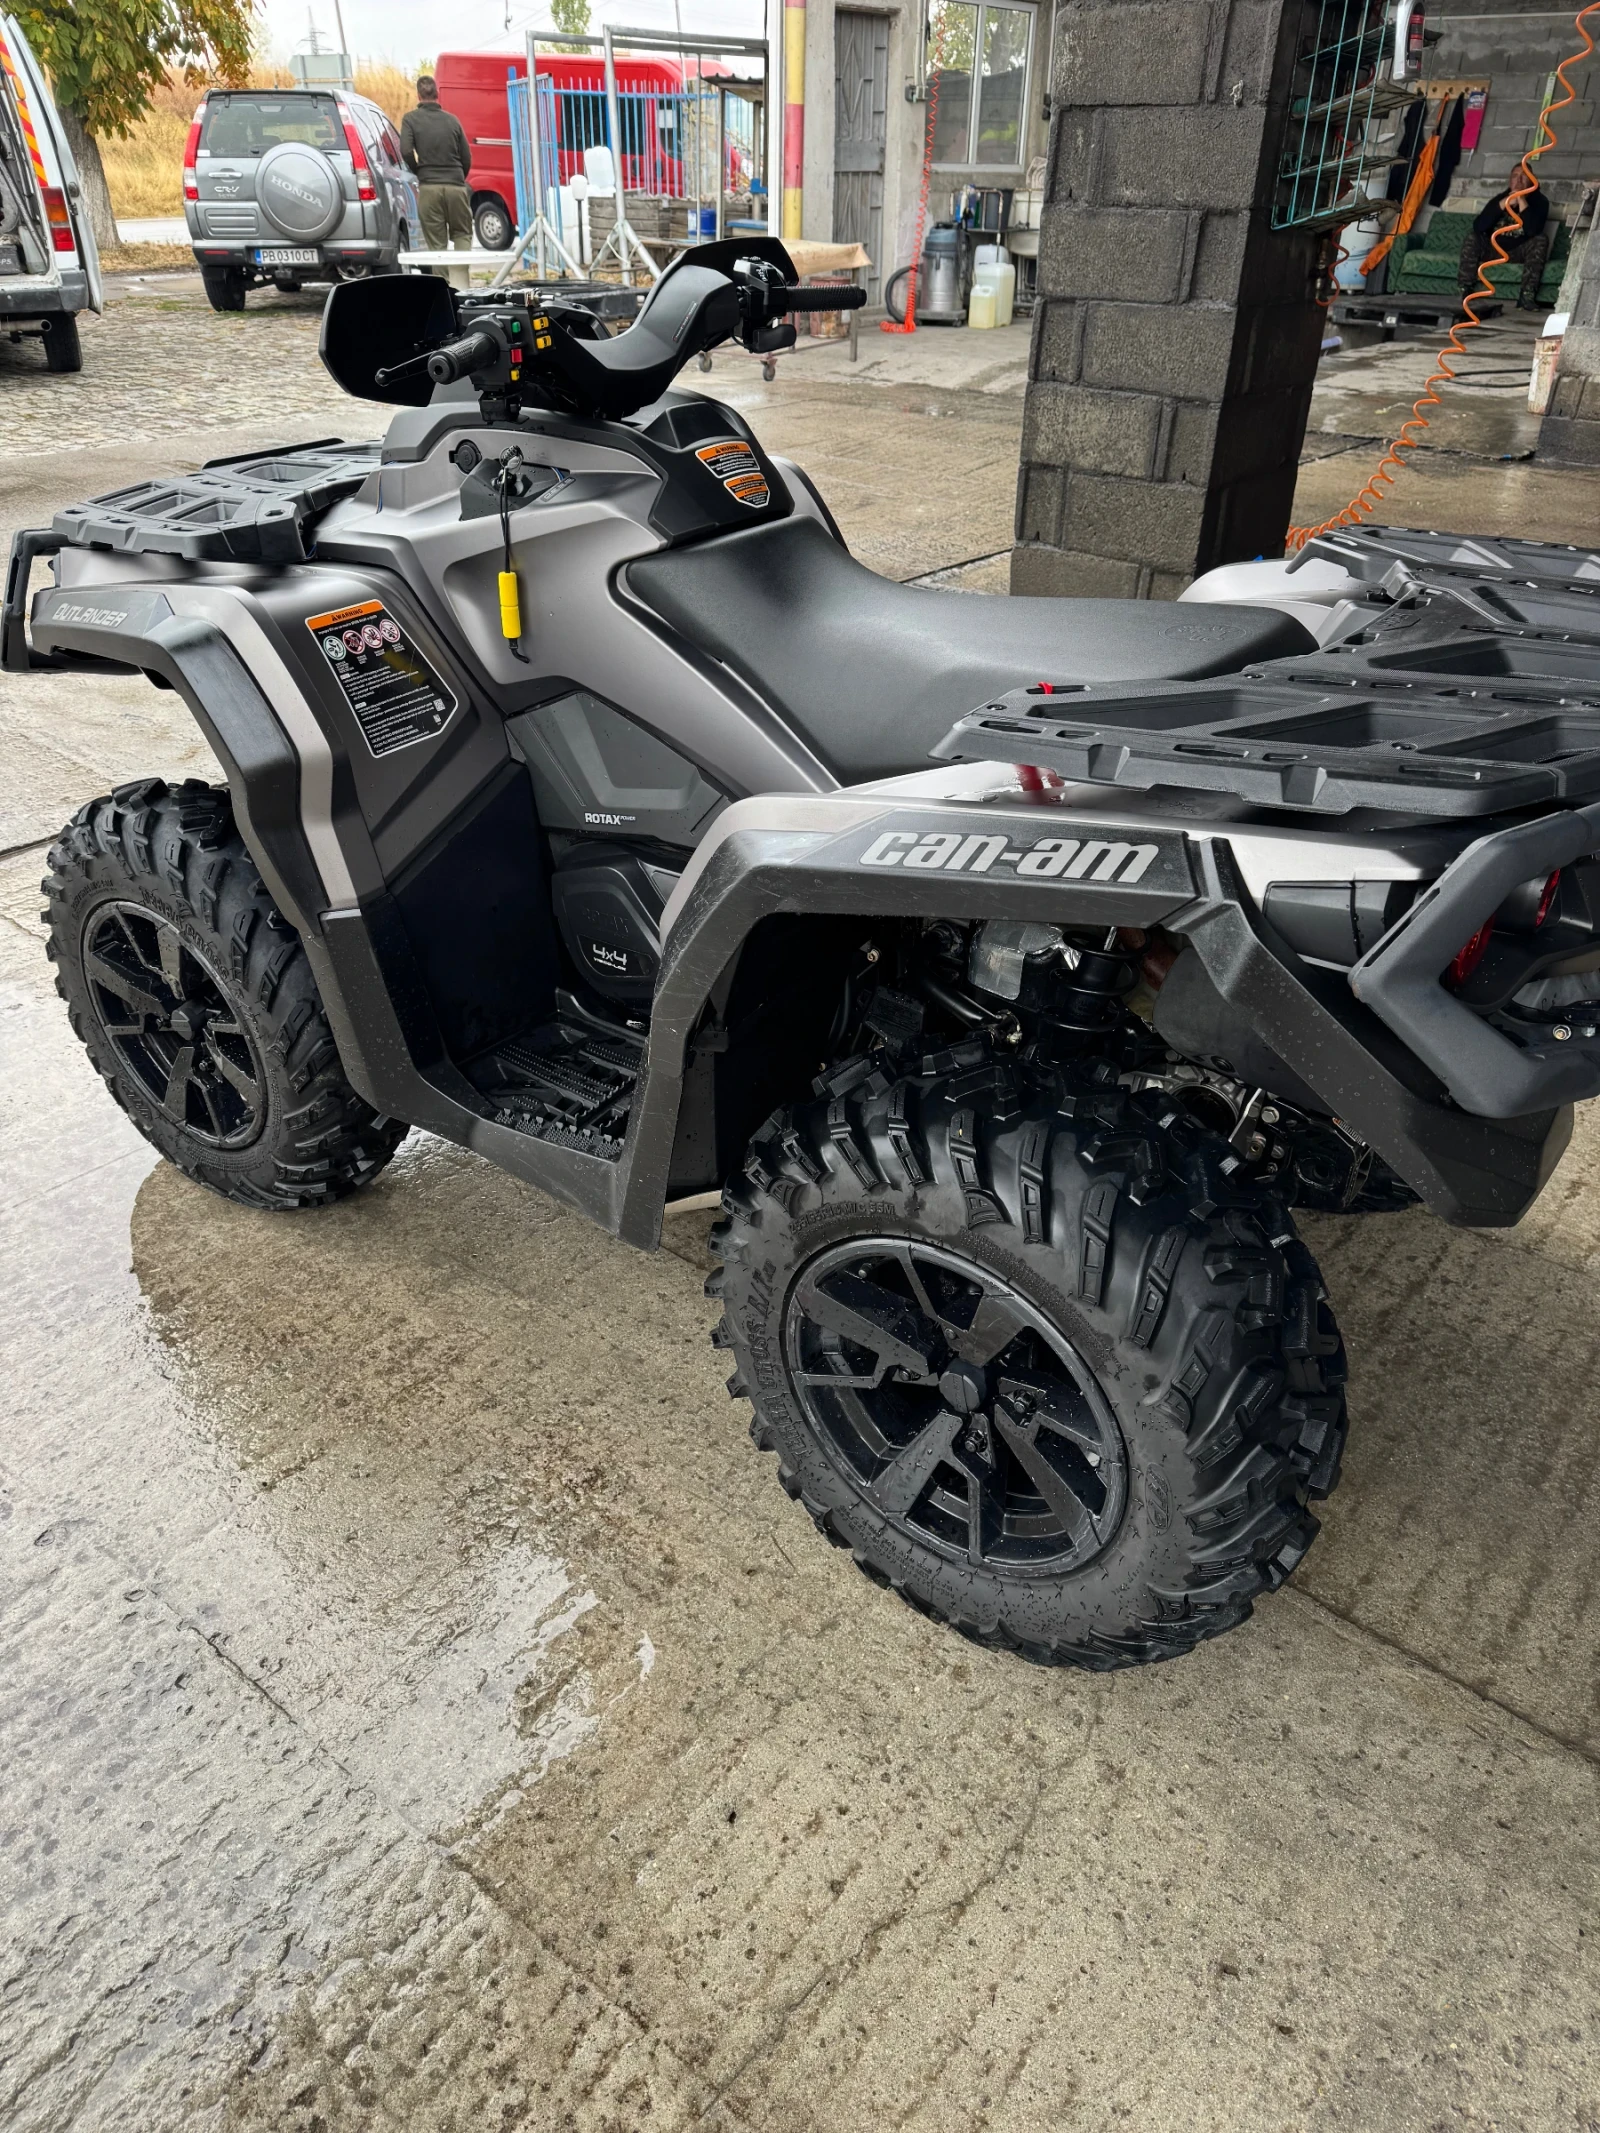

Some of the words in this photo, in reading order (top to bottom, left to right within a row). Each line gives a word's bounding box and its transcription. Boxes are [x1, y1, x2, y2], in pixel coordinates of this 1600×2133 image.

[270, 174, 323, 209] HONDA
[262, 250, 275, 261] PB
[277, 250, 301, 262] 0310
[302, 250, 316, 261] CT
[52, 602, 129, 627] OUTLANDER
[335, 608, 364, 620] WARNING
[584, 812, 621, 825] ROTAX
[859, 831, 1160, 884] can-am
[593, 943, 627, 965] 4x4
